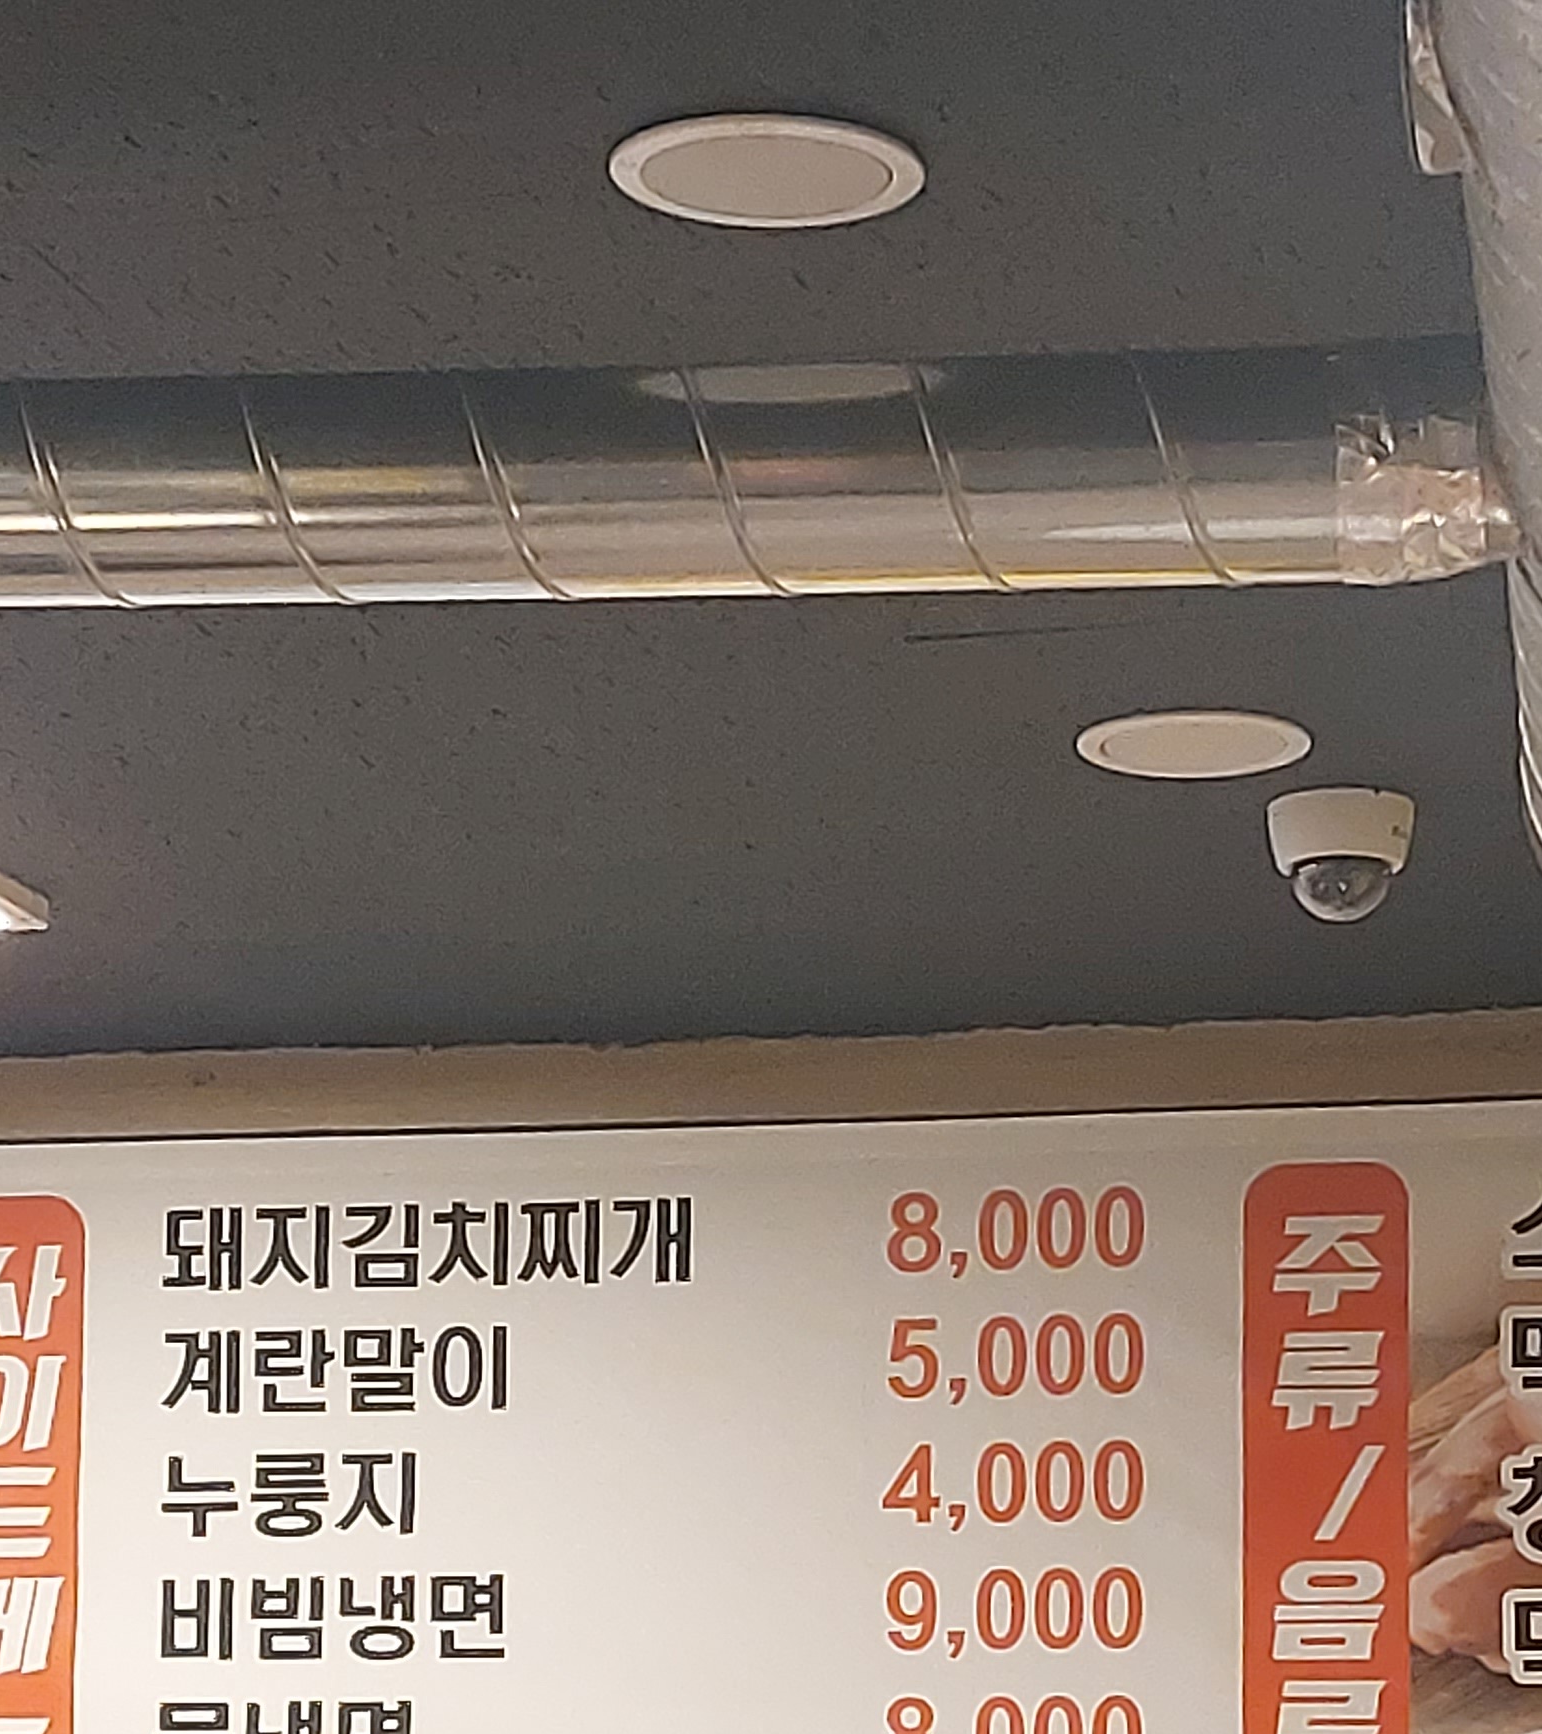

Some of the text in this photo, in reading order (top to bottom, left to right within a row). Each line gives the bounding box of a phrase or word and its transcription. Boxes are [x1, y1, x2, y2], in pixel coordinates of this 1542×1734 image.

[163, 1189, 1143, 1290] 돼지김치찌개 8,000
[162, 1313, 1143, 1413] 계란말이 5,000
[162, 1440, 1144, 1536] 누룽지 4,000
[162, 1567, 1143, 1659] 비빔냉면 9,000
